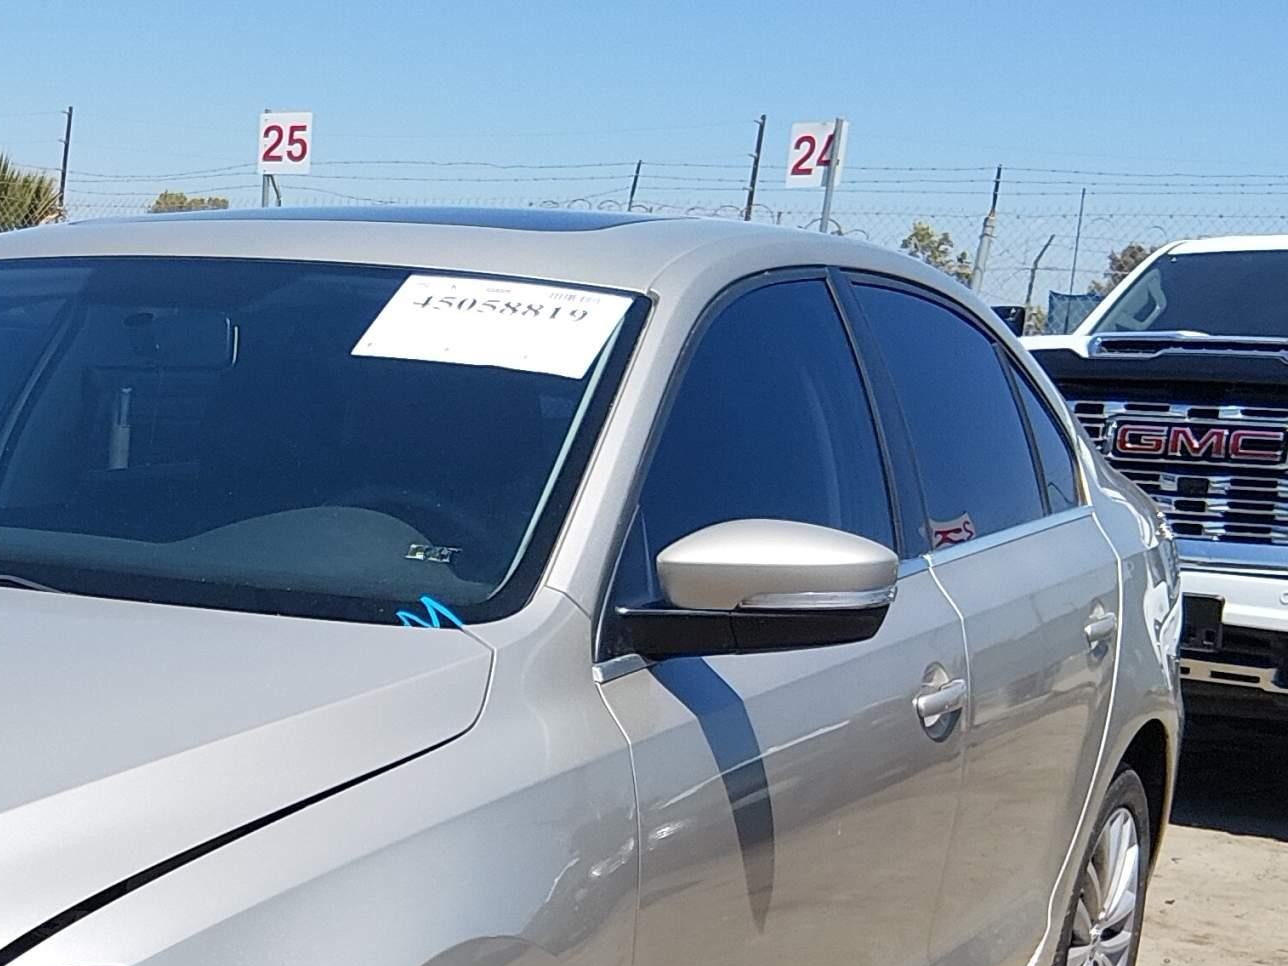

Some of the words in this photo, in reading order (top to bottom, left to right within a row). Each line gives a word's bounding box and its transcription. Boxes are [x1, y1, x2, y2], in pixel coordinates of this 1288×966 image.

[262, 124, 308, 162] 25
[412, 294, 589, 322] 45058819
[1116, 423, 1284, 462] GMC
